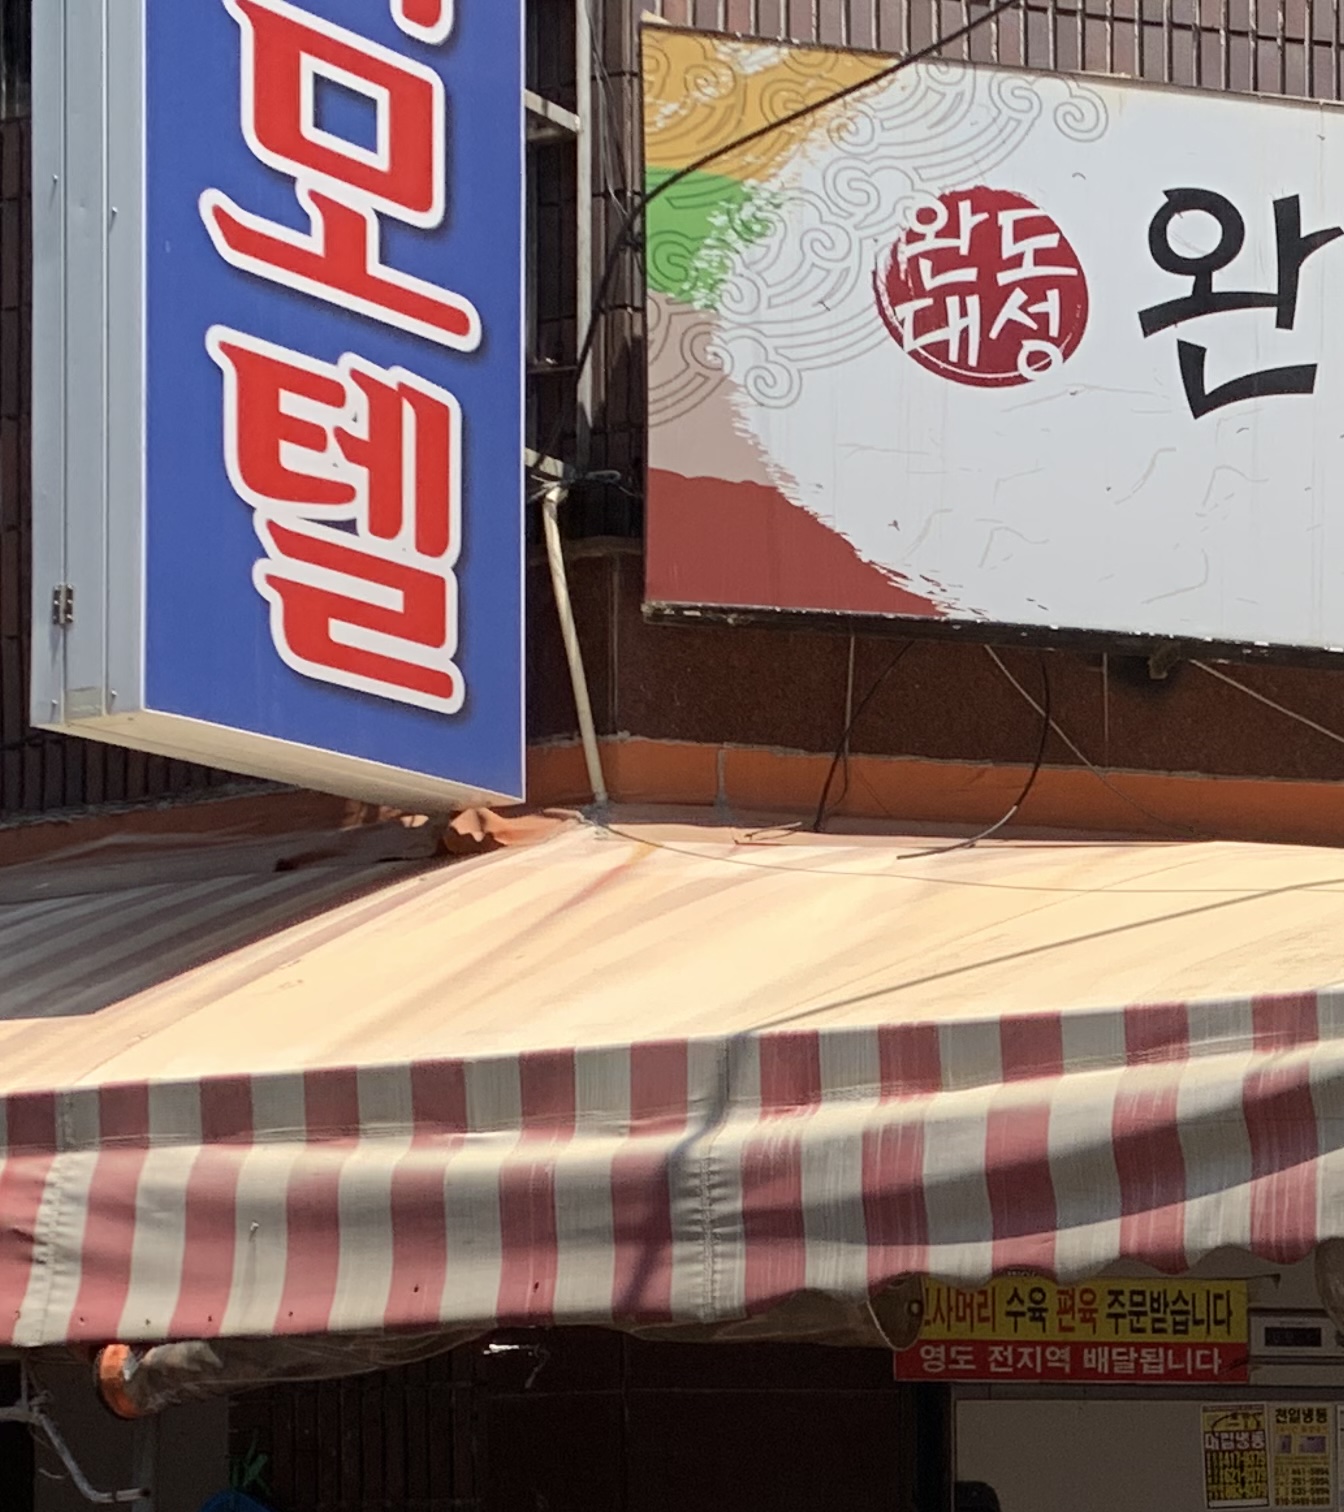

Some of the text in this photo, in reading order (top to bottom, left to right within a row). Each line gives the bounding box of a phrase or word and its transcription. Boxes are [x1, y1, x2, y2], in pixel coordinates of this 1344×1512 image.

[903, 196, 1078, 287] 완도
[203, 0, 480, 712] 모텔
[894, 287, 1066, 383] 대성
[925, 1285, 1233, 1336] 사머리 수육 편육 주문받습니다
[920, 1345, 1222, 1376] 영도 전지역 배달됩니다
